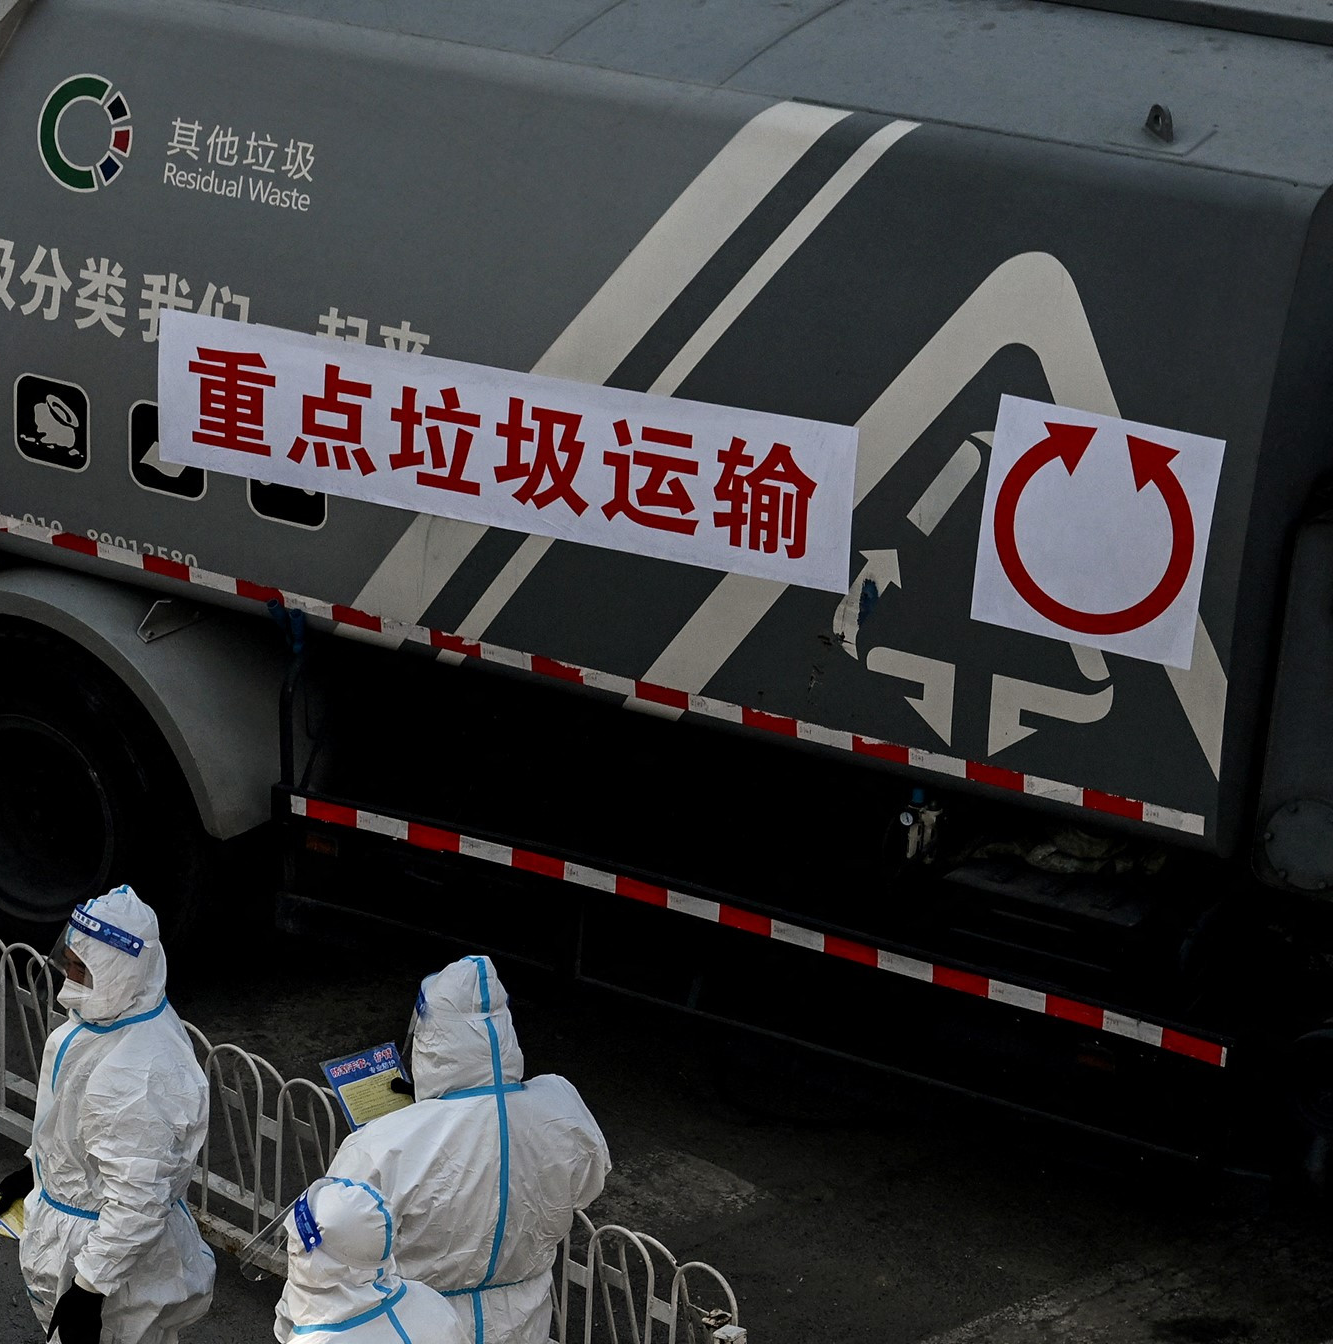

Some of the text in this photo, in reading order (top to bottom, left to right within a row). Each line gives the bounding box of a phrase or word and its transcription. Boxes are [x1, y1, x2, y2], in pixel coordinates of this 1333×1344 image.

[167, 117, 315, 182] 其他垃圾
[164, 162, 311, 211] Residual Waste
[188, 346, 818, 559] 重点垃圾运输
